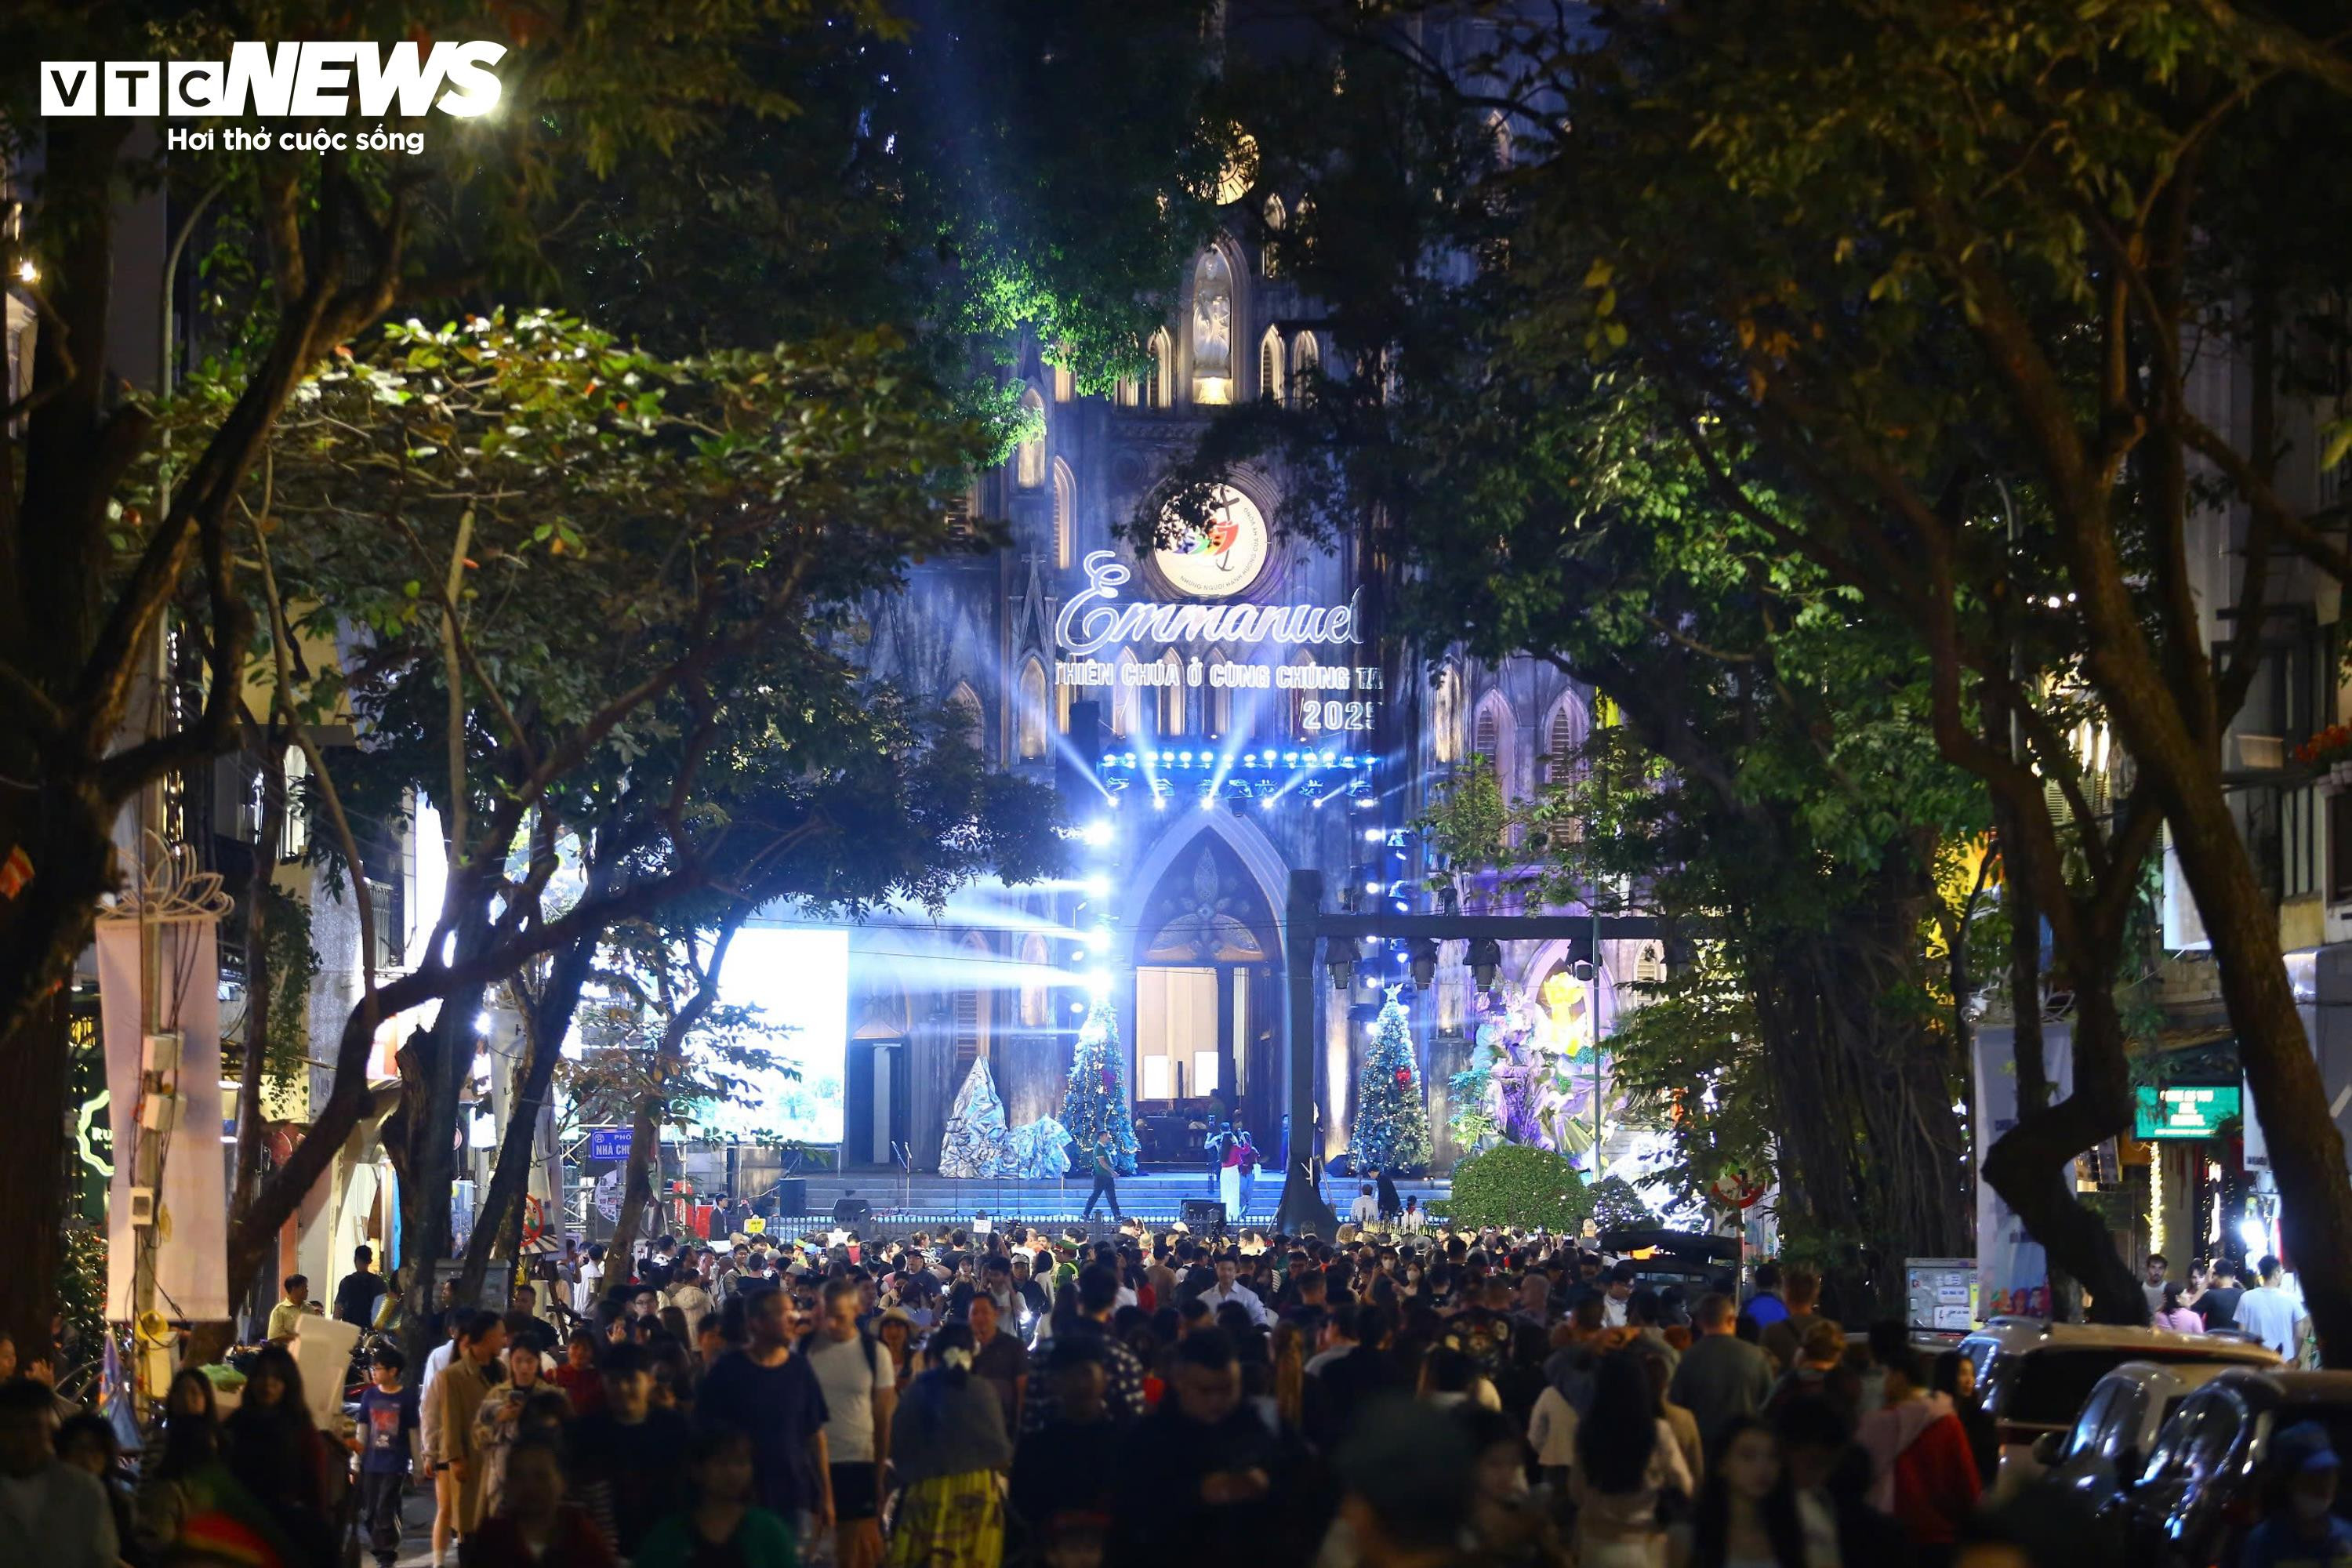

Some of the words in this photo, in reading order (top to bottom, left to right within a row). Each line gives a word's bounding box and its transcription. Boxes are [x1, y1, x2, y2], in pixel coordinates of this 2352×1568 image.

[1055, 550, 1365, 656] Emmanuel
[1054, 659, 1114, 686] THIÊN
[1121, 659, 1181, 687] CHÚA
[1186, 655, 1203, 688] Ở
[1209, 660, 1271, 688] CÙNG
[1276, 661, 1350, 689] CHÚNG
[596, 1142, 614, 1156] NHÀ
